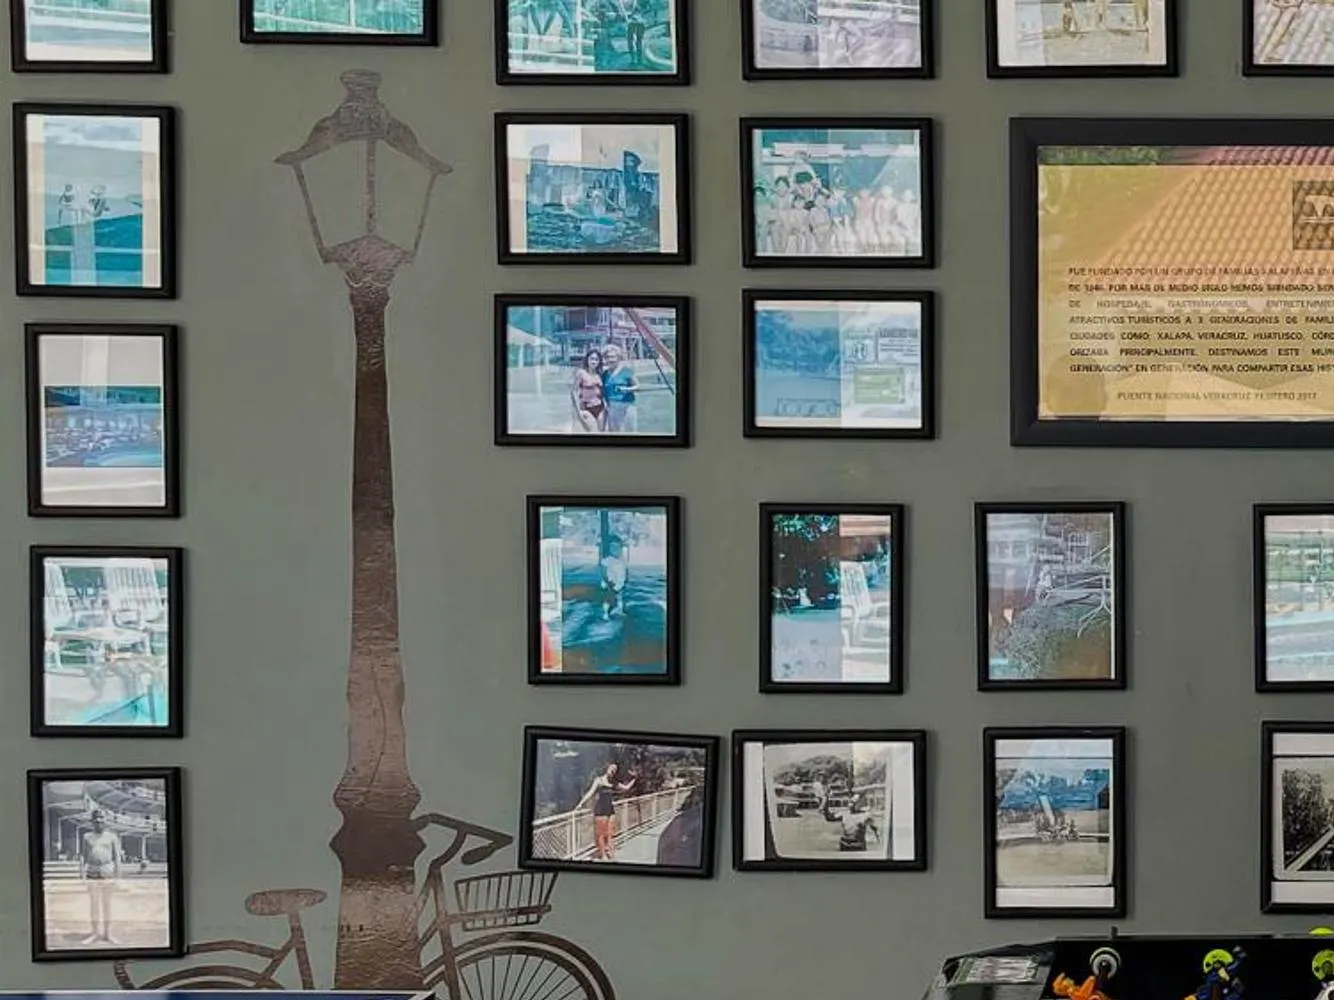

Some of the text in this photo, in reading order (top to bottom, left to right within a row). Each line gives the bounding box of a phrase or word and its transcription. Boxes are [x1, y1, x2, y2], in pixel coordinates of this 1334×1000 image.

[1109, 283, 1128, 293] POR
[1153, 283, 1165, 293] DE
[1169, 283, 1198, 293] MEDIO
[1230, 283, 1264, 293] HEMOS
[1069, 315, 1125, 324] ATRACTIVOS
[1185, 315, 1192, 324] A
[1209, 315, 1279, 324] GENERACIONES
[1285, 315, 1298, 324] DE
[1070, 331, 1115, 341] CIUDADES
[1208, 347, 1268, 357] DESTINAMOS
[1278, 347, 1300, 357] ESTE
[1135, 363, 1148, 373] EN
[1211, 363, 1235, 373] PARA
[1237, 363, 1288, 373] COMPARTIR
[1290, 363, 1314, 373] ESAS
[1117, 391, 1153, 401] PUENTE
[1155, 391, 1201, 401] NACIONAL
